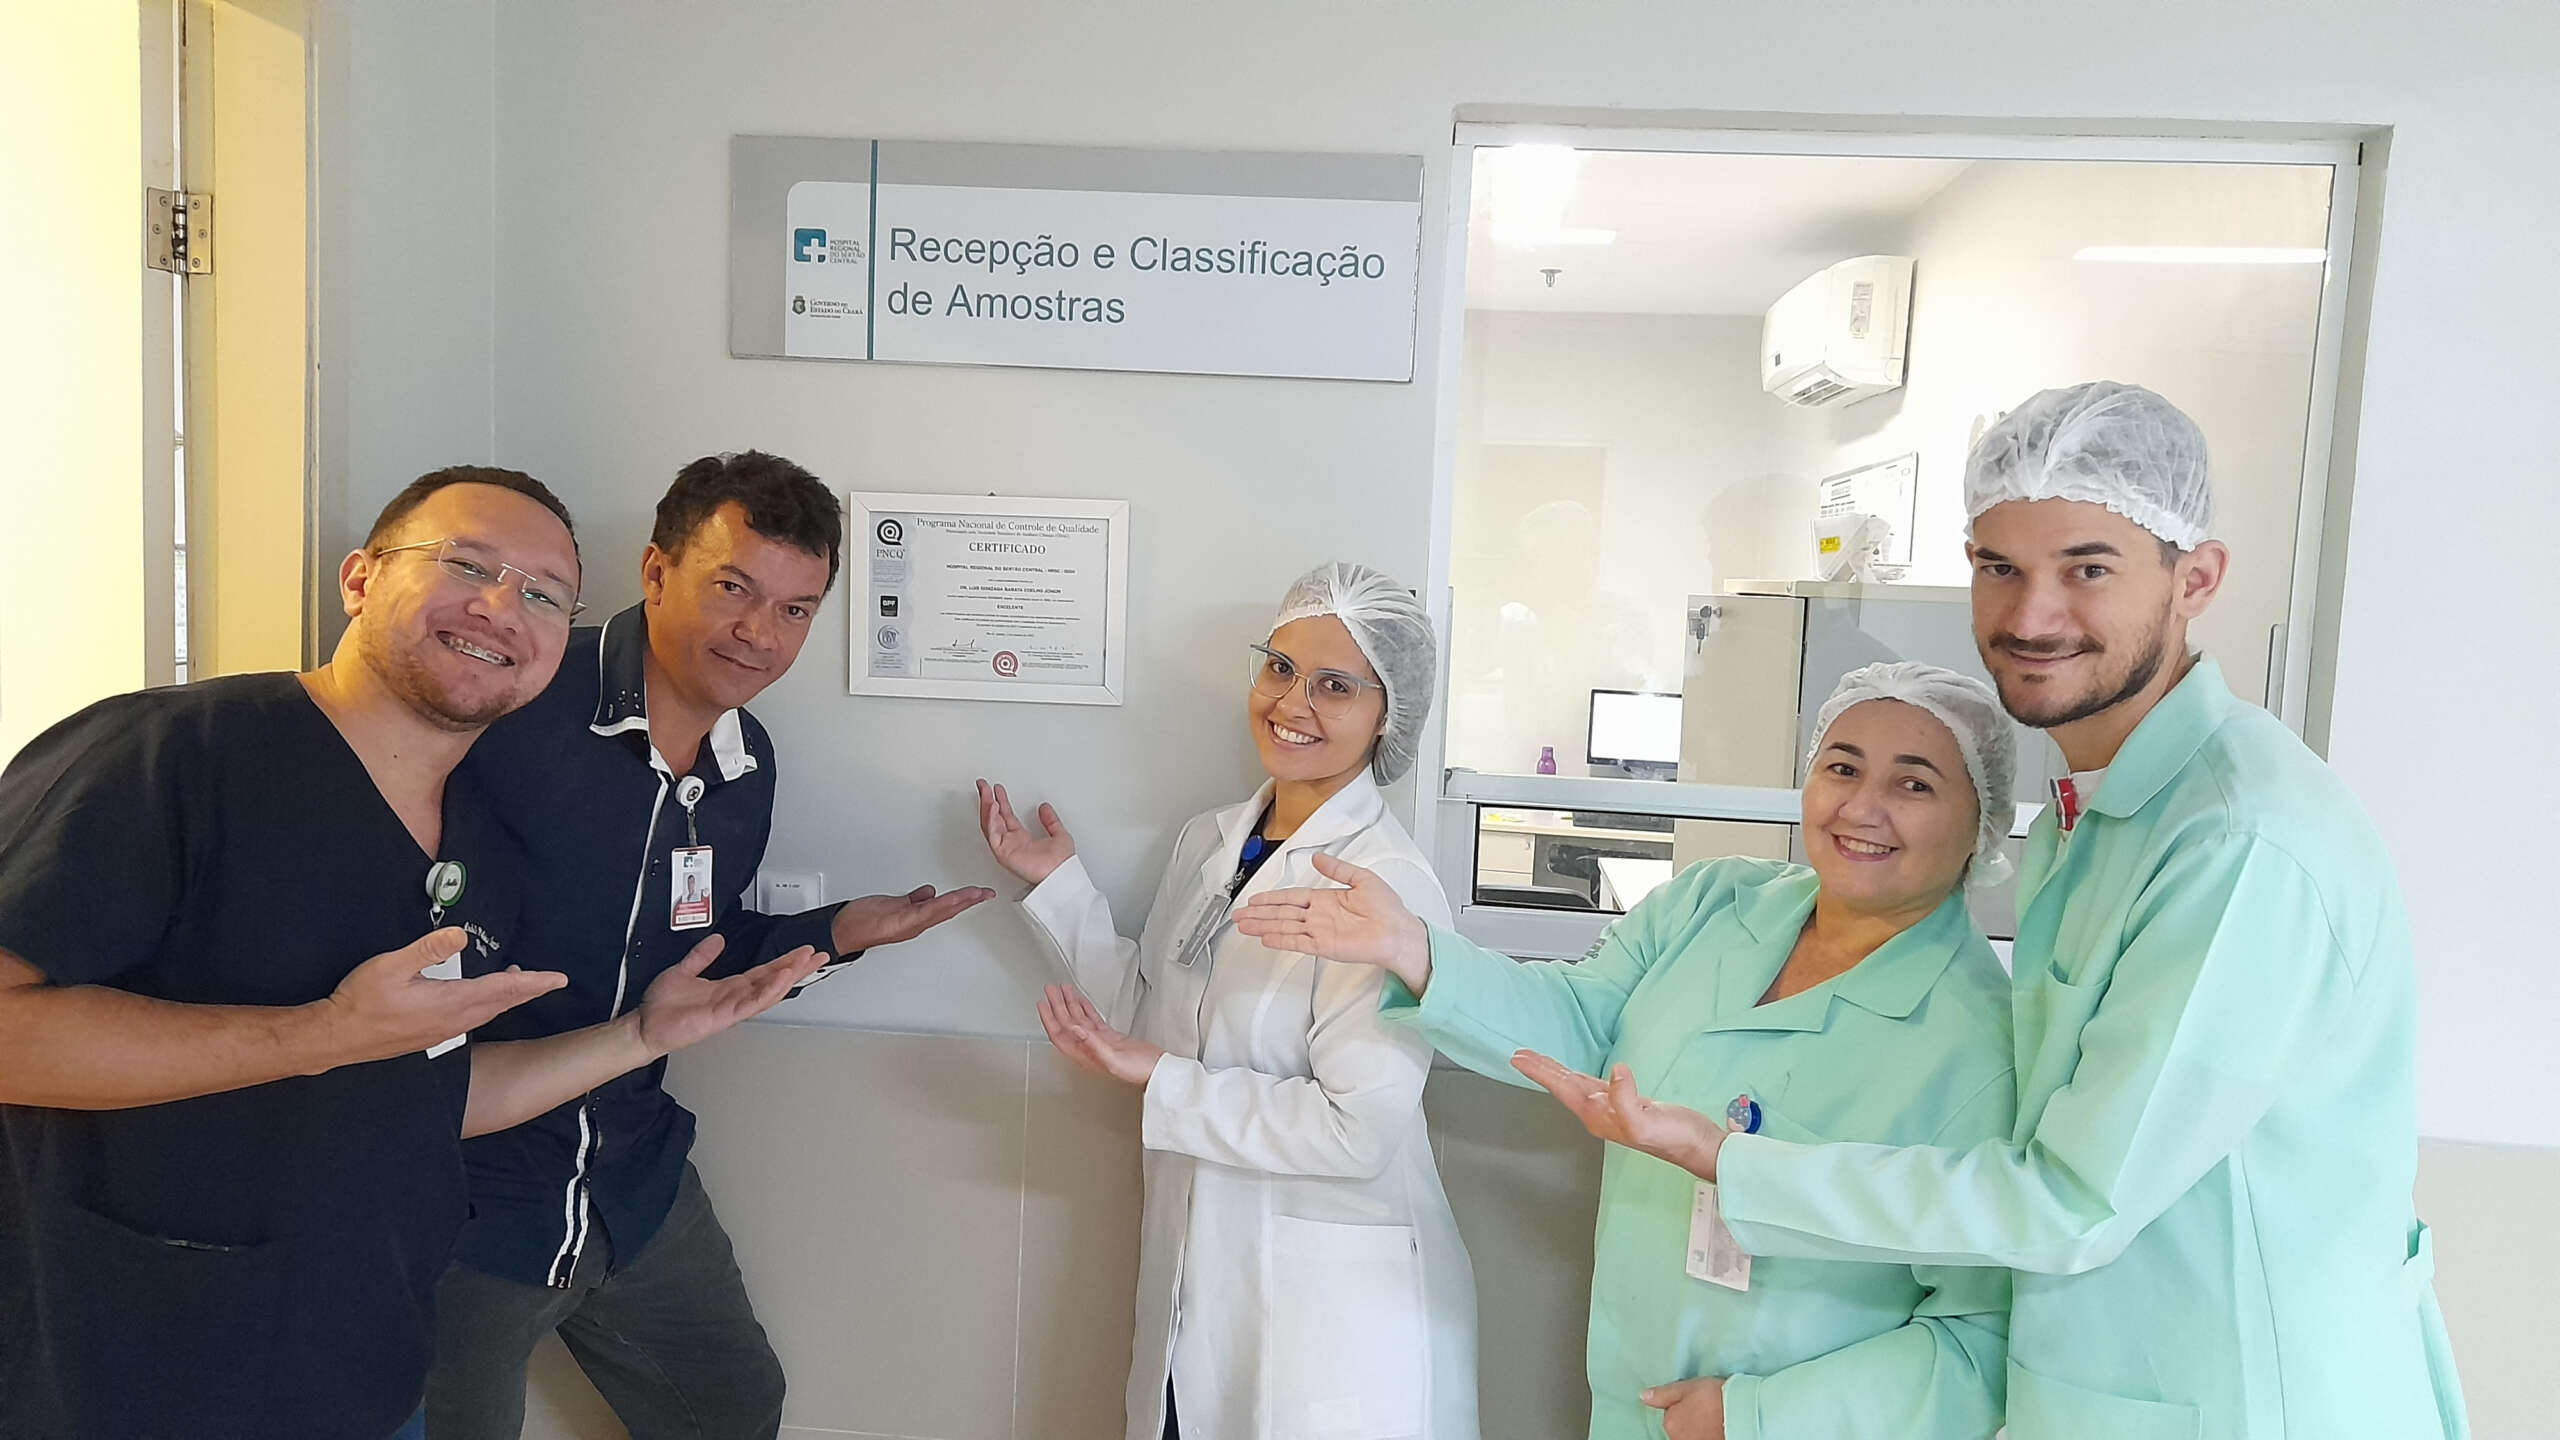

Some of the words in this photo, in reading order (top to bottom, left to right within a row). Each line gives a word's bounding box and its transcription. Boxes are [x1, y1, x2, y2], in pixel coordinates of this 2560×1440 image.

[890, 227, 1079, 275] Recepção
[1093, 244, 1115, 269] e
[1130, 236, 1385, 287] Classificação
[887, 281, 933, 316] de
[945, 284, 1125, 324] Amostras
[917, 517, 956, 529] Programa
[958, 519, 994, 530] Nacional
[996, 520, 1006, 530] de
[1008, 521, 1044, 531] Controle
[1046, 522, 1056, 532] de
[1058, 523, 1100, 534] Qualidade
[969, 542, 1046, 554] CERTIFICADO
